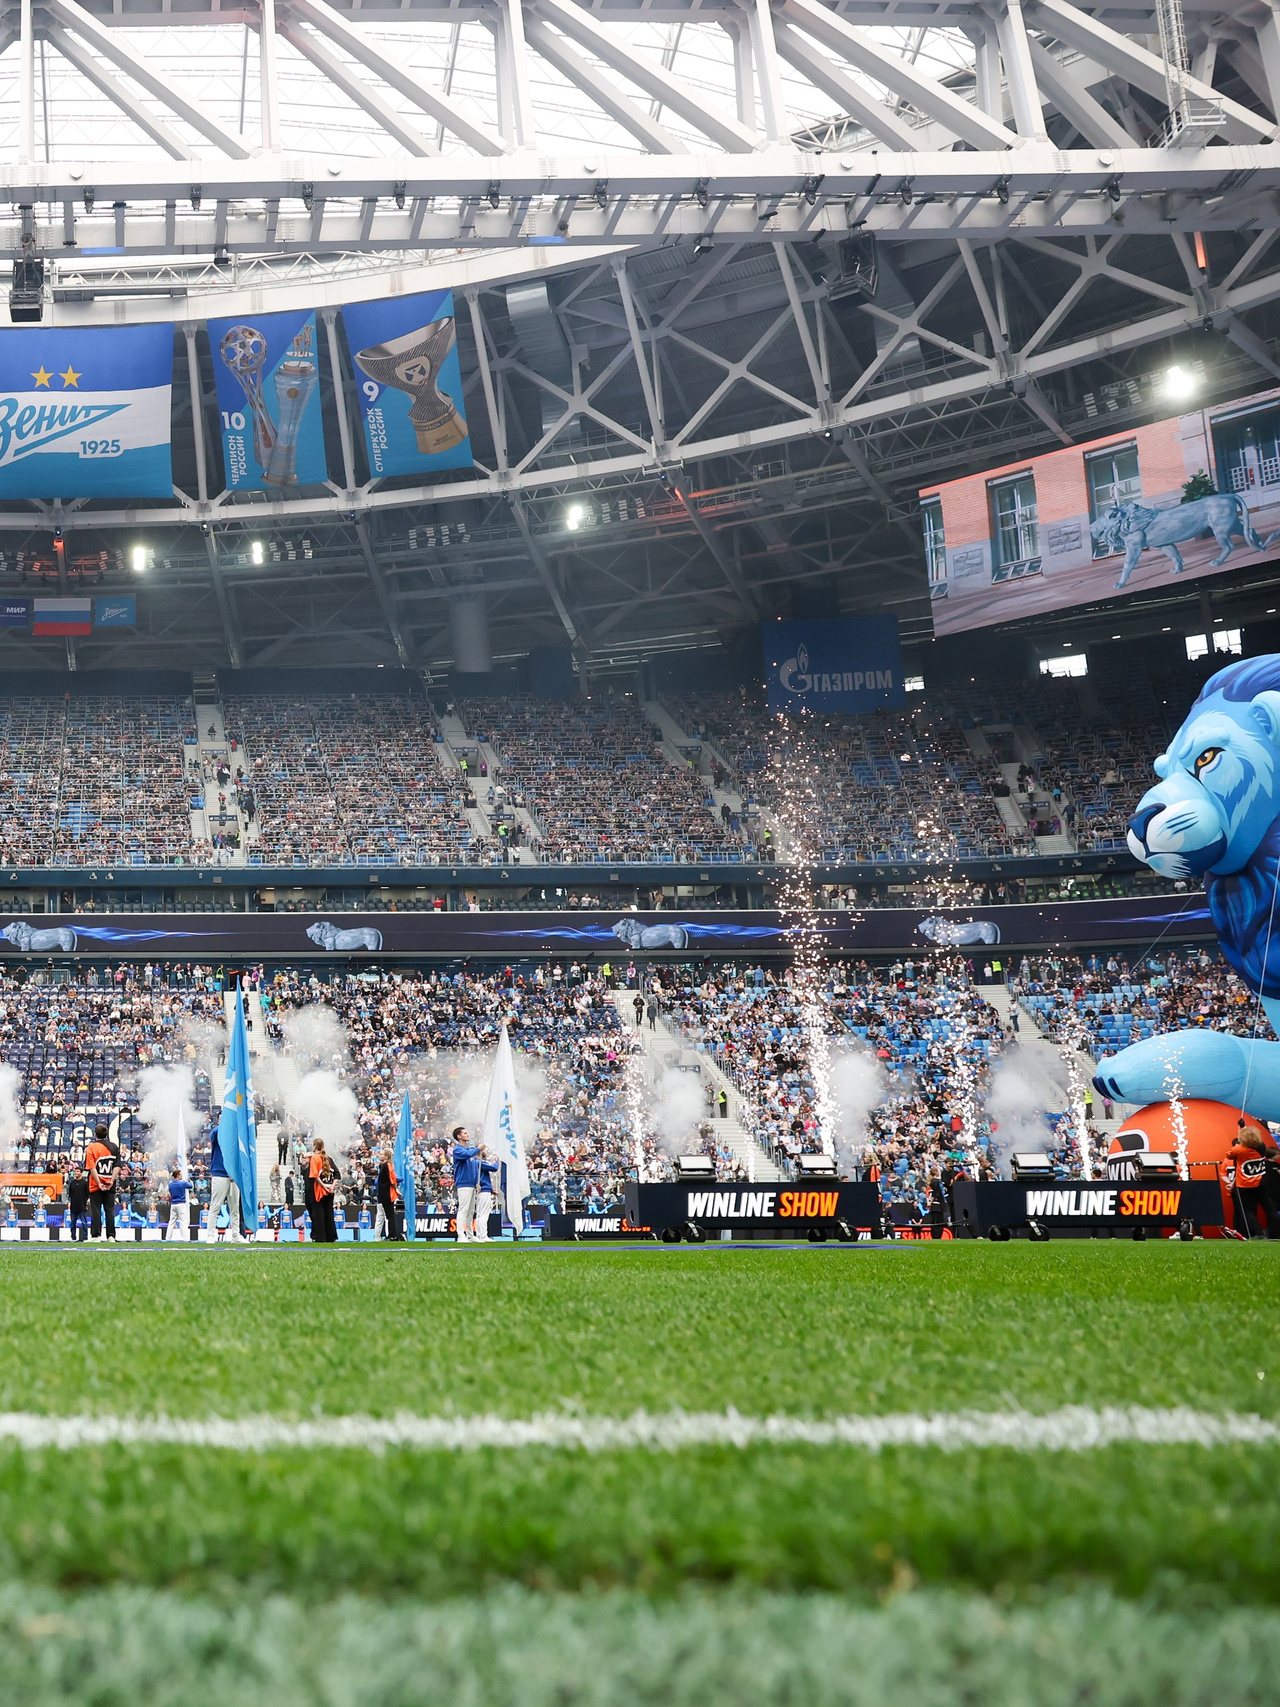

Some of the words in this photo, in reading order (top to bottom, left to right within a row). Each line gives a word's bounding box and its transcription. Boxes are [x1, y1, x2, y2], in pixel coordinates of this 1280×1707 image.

[363, 381, 379, 402] 9
[221, 411, 246, 431] 10
[374, 408, 388, 449] РОССИИ
[80, 439, 121, 455] 1925
[366, 408, 384, 472] СУПЕРКУБОК
[227, 435, 240, 485] ЧЕМПИОН
[236, 436, 247, 476] РОССИИ
[813, 670, 893, 692] ГАЗПРОМ
[687, 1192, 776, 1218] WINLINE
[778, 1191, 839, 1218] SHOW
[1026, 1190, 1117, 1216] WINLINE
[1119, 1190, 1181, 1216] SHOW
[574, 1218, 621, 1232] WINLINE
